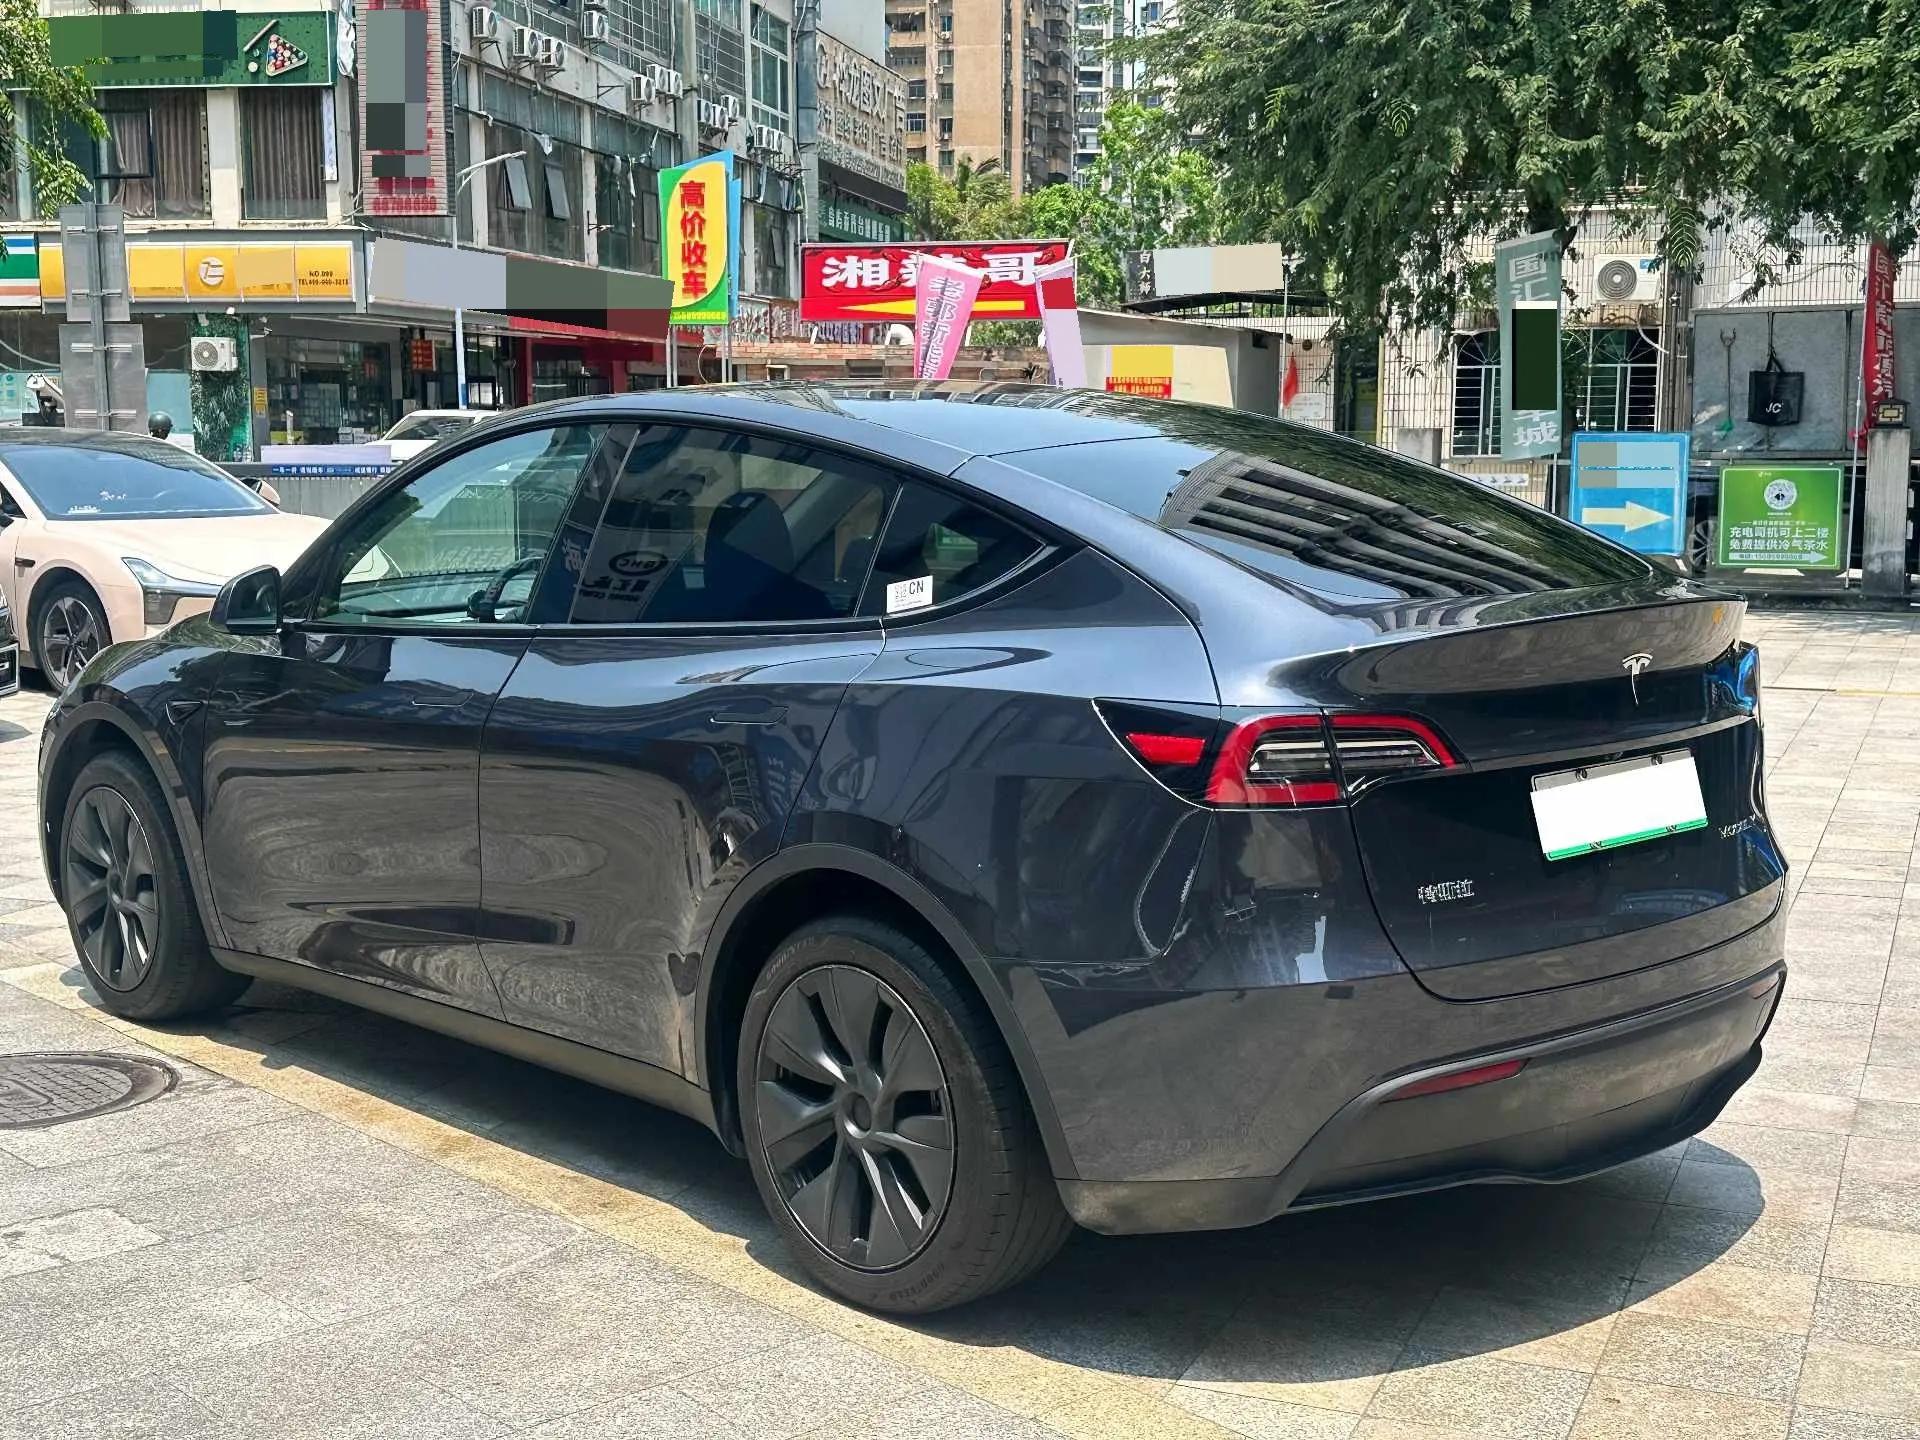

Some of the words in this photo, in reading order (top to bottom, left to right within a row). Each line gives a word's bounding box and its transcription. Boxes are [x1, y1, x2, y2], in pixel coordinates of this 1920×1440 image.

[679, 180, 708, 299] 高价收车
[821, 250, 1042, 290] 湘哥
[1730, 526, 1829, 538] 充电司机可上二楼
[1730, 538, 1829, 551] 免费提供冷气茶水
[909, 580, 924, 595] CN
